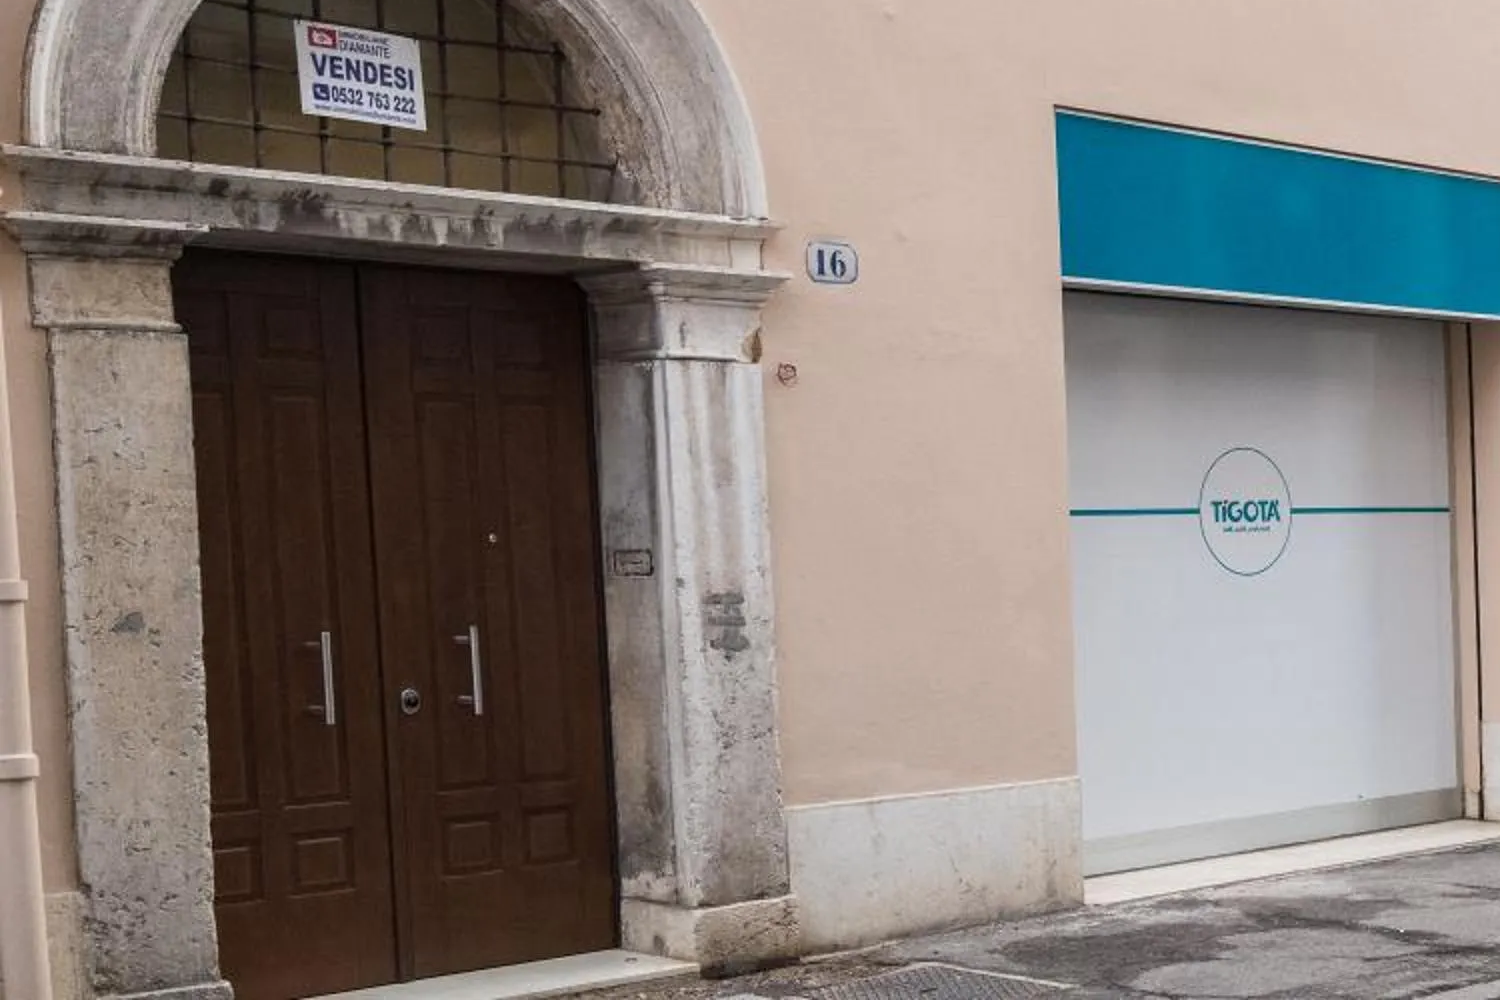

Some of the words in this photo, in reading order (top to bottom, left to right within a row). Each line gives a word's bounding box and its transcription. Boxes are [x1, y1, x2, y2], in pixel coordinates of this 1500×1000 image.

[339, 40, 391, 59] DIAMANTE
[310, 52, 415, 92] VENDESI
[331, 85, 364, 107] 0532
[367, 91, 391, 111] 763
[394, 96, 416, 115] 222
[816, 249, 847, 278] 16
